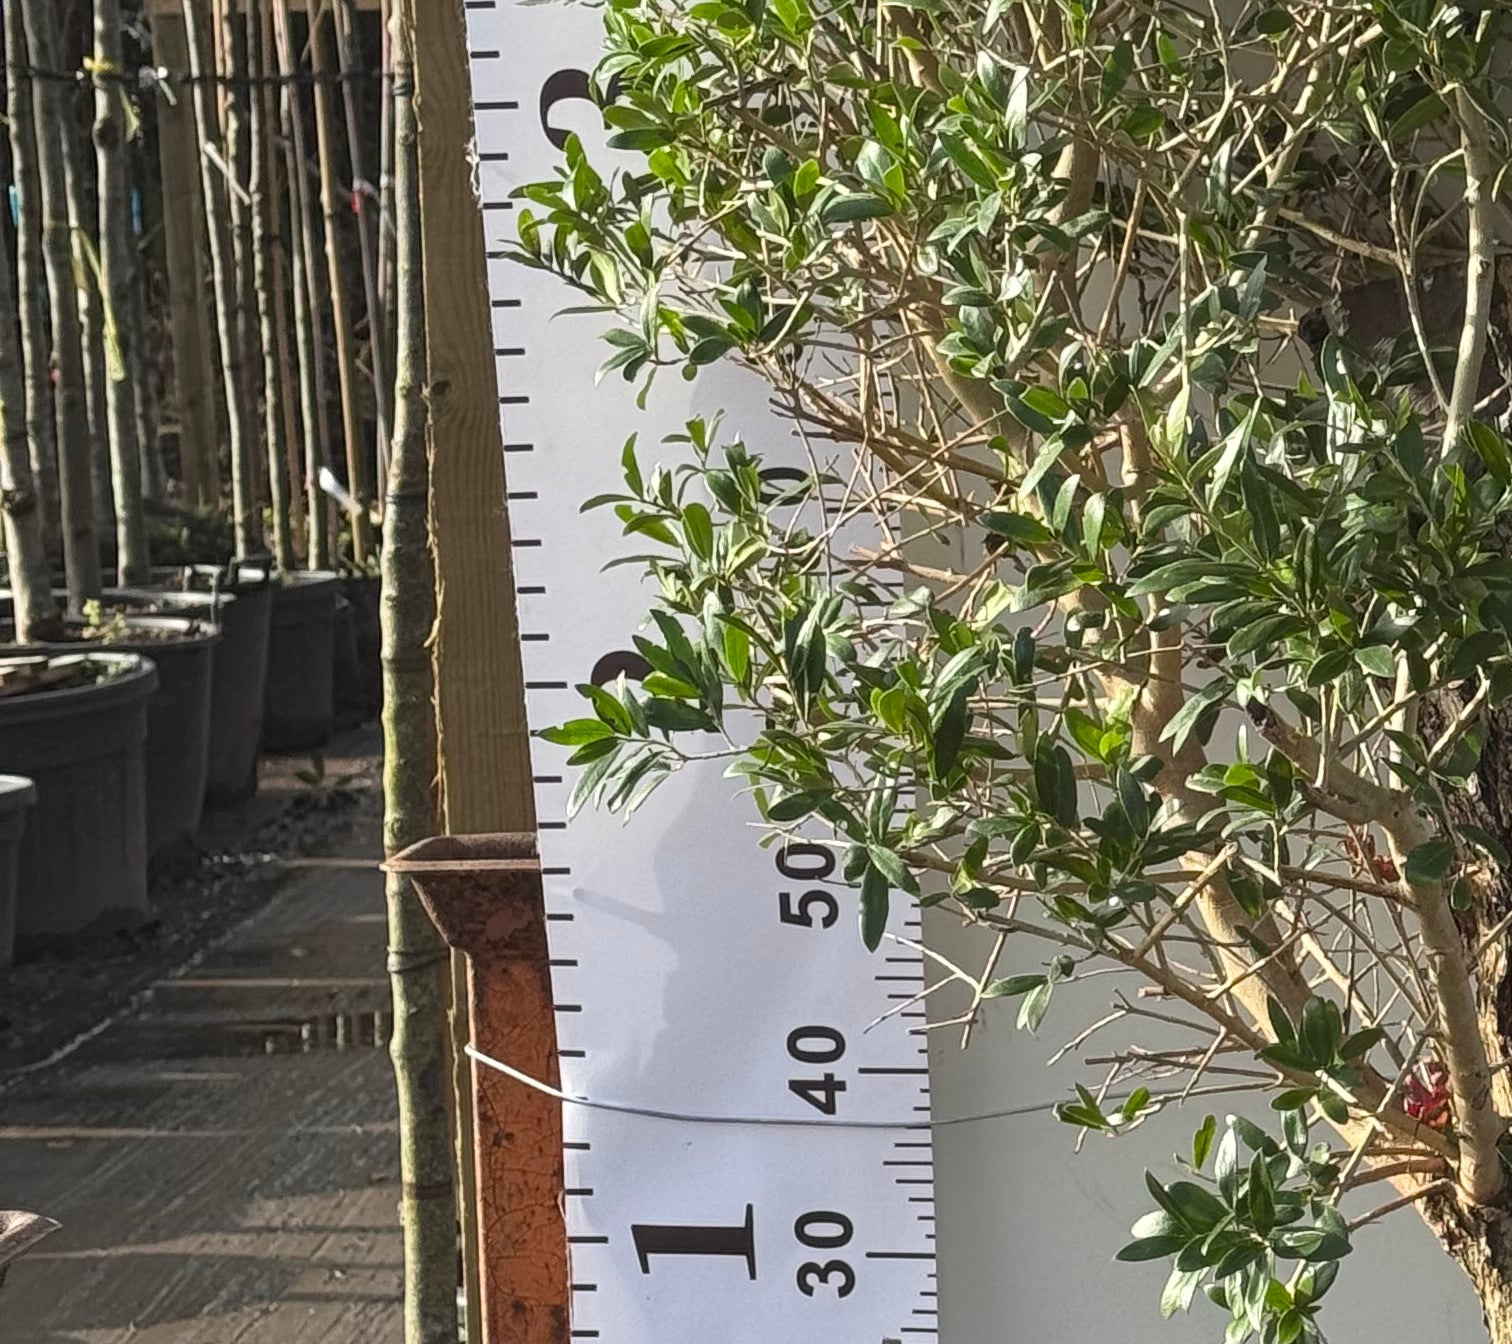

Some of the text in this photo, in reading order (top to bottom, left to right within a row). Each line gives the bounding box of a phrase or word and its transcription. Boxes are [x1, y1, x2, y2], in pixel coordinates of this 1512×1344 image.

[775, 842, 839, 929] 50
[787, 1025, 847, 1116] 40
[631, 1203, 757, 1281] 1
[795, 1210, 856, 1299] 30
